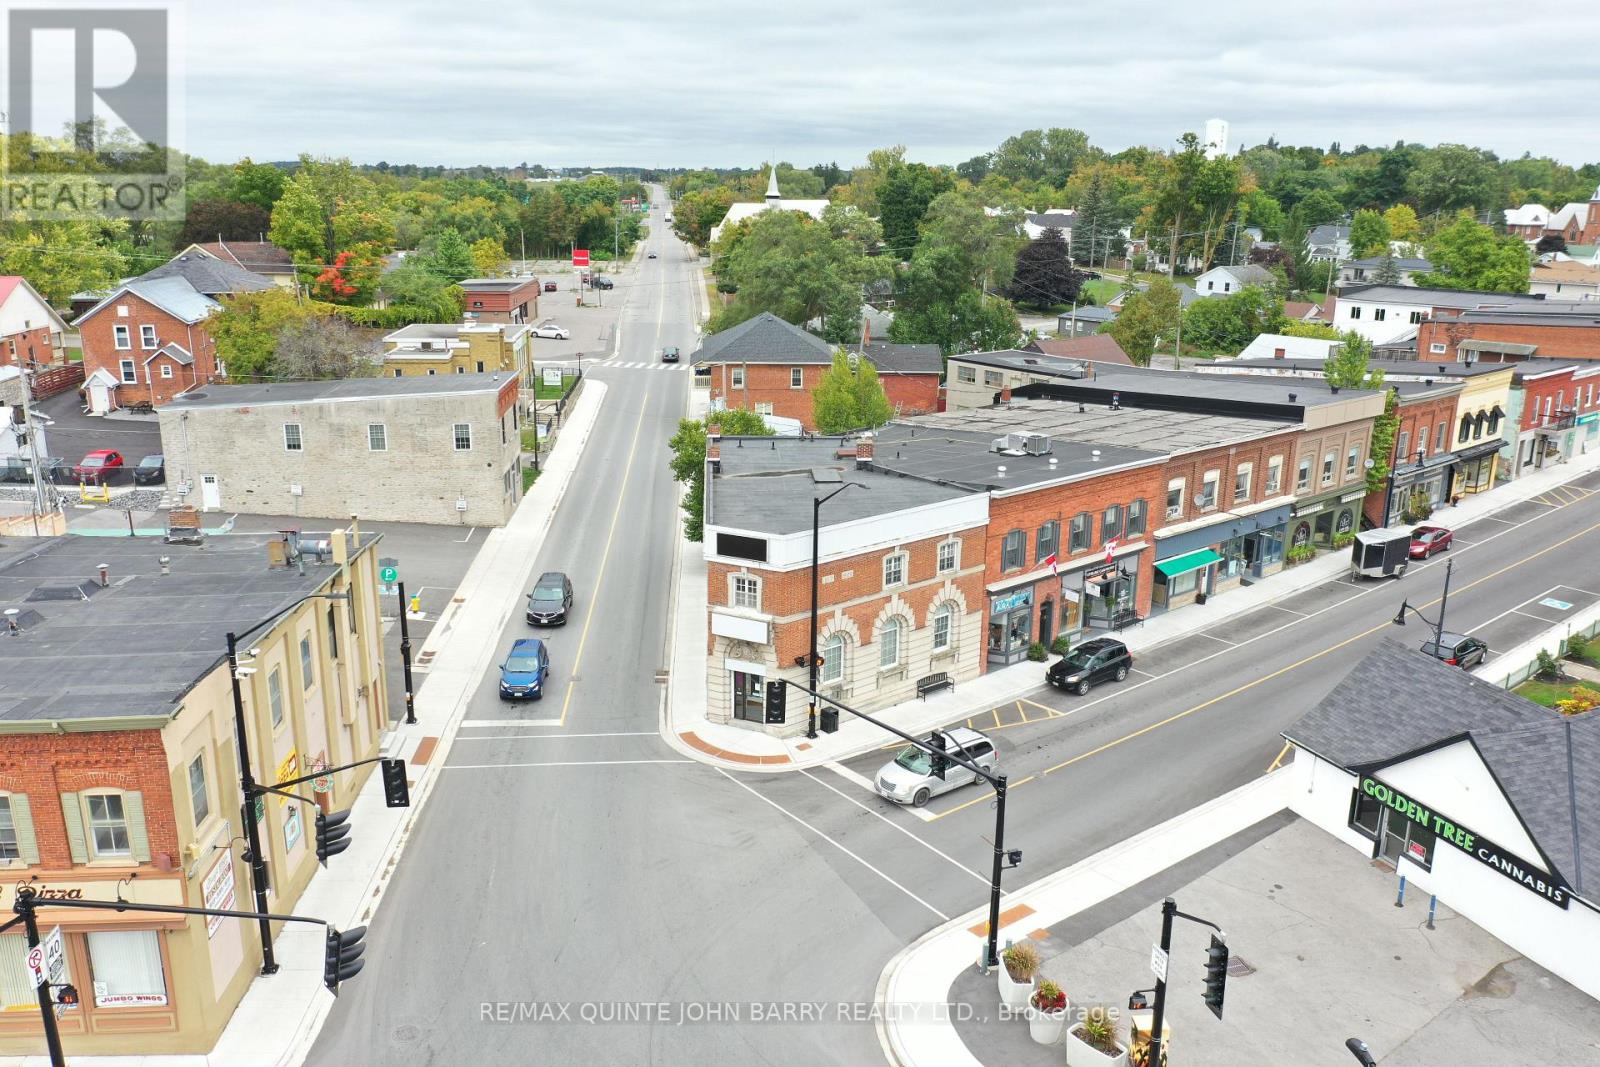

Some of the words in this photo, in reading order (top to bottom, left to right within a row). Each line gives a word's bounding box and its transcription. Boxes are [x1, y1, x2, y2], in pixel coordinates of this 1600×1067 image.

[1363, 778, 1430, 827] GOLDEN
[1433, 815, 1476, 852] TREE
[1478, 848, 1563, 902] CANNABIS
[49, 939, 60, 959] 40
[101, 995, 133, 1003] JUMBO
